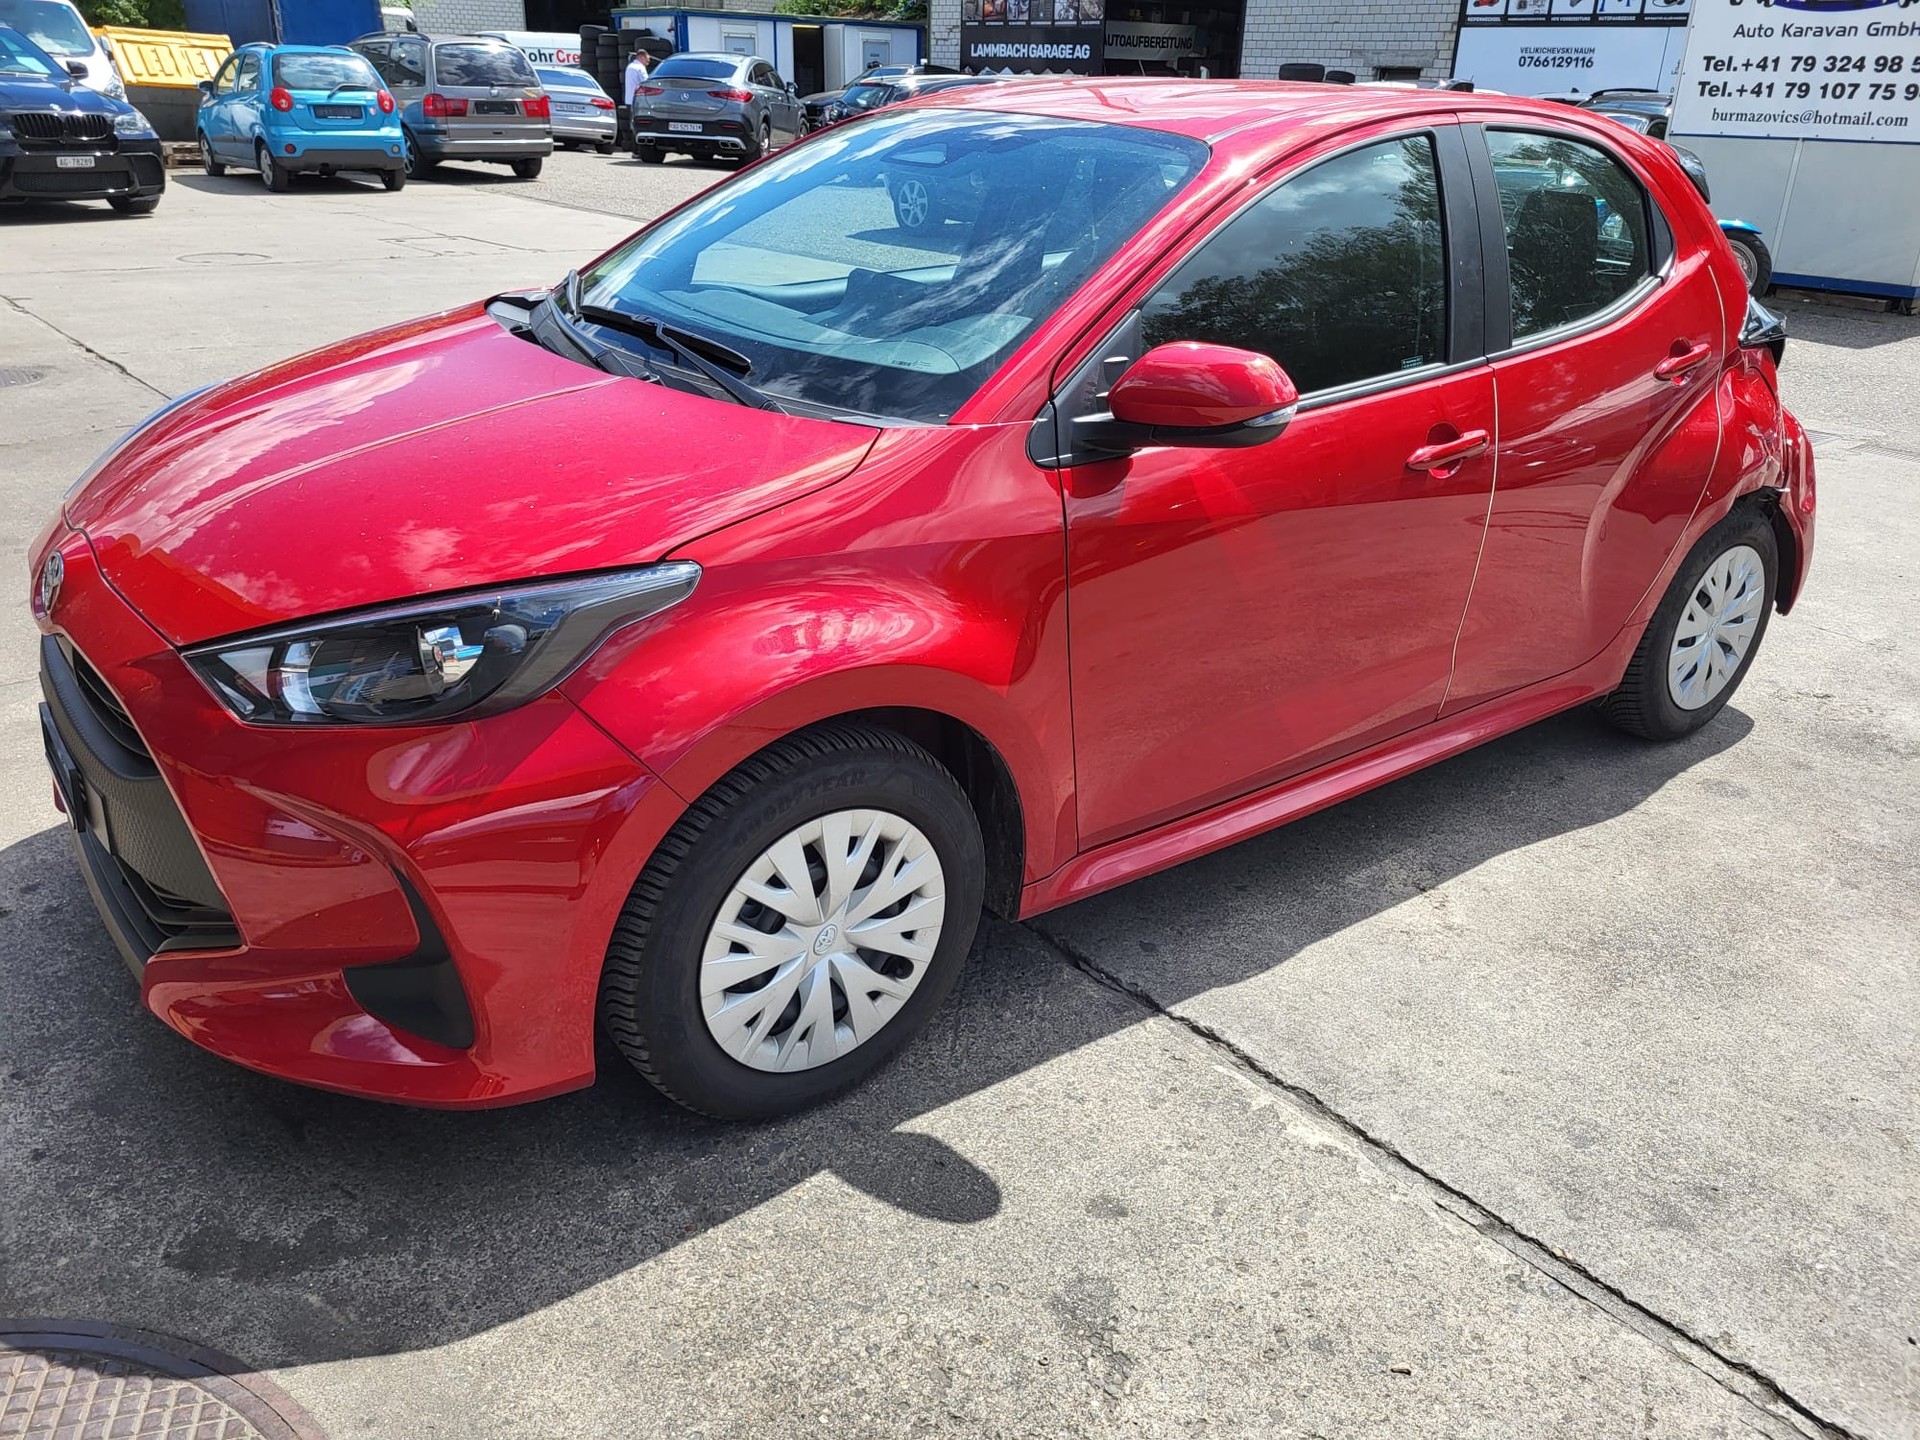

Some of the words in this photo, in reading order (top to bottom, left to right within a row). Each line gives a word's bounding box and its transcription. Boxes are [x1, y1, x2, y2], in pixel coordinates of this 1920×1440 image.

[1733, 23, 1775, 38] Auto
[1781, 22, 1858, 38] Karavan
[1866, 21, 1920, 37] GmbH
[970, 43, 1028, 58] LAMMBACH
[1028, 44, 1073, 59] GARAGE
[1073, 44, 1091, 59] AG
[1520, 46, 1573, 55] VELIKICHEVSKI
[1573, 47, 1596, 55] NAUM
[1518, 55, 1594, 68] 0766129116
[1703, 55, 1781, 72] Tel.+41
[1791, 56, 1816, 72] 79
[1823, 56, 1866, 73] 324
[1874, 55, 1904, 73] 98
[1698, 81, 1774, 98] Tel.+41
[1785, 82, 1811, 98] 79
[1820, 83, 1861, 99] 107
[1869, 83, 1896, 100] 75
[1711, 107, 1909, 127] burmazovics@hotmail.com
